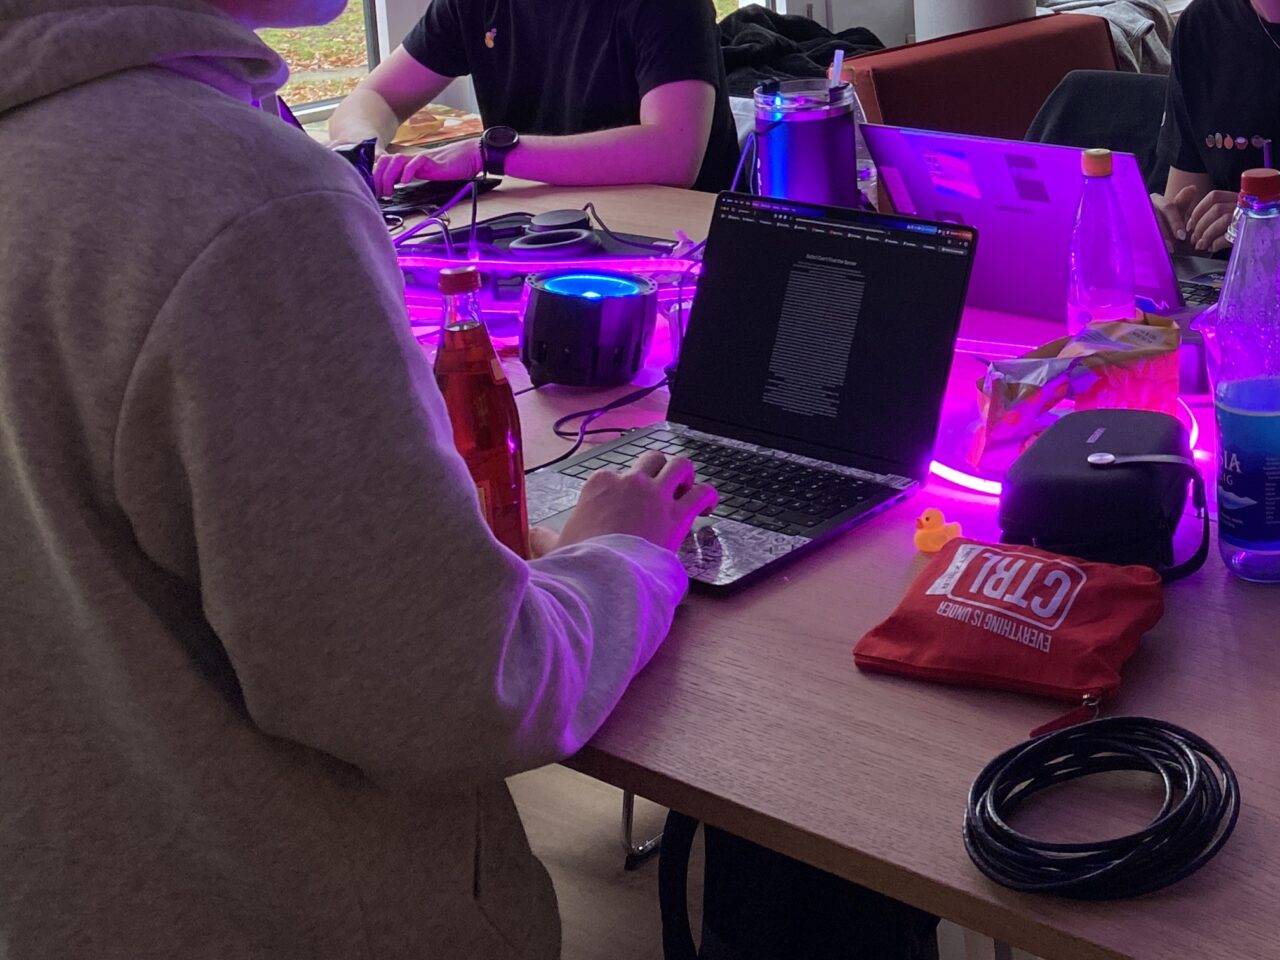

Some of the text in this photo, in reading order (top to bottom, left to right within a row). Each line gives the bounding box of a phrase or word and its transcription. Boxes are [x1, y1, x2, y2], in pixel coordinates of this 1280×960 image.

[969, 552, 1071, 618] CTRL
[936, 601, 1052, 653] EVERYTHING IS UNDER
